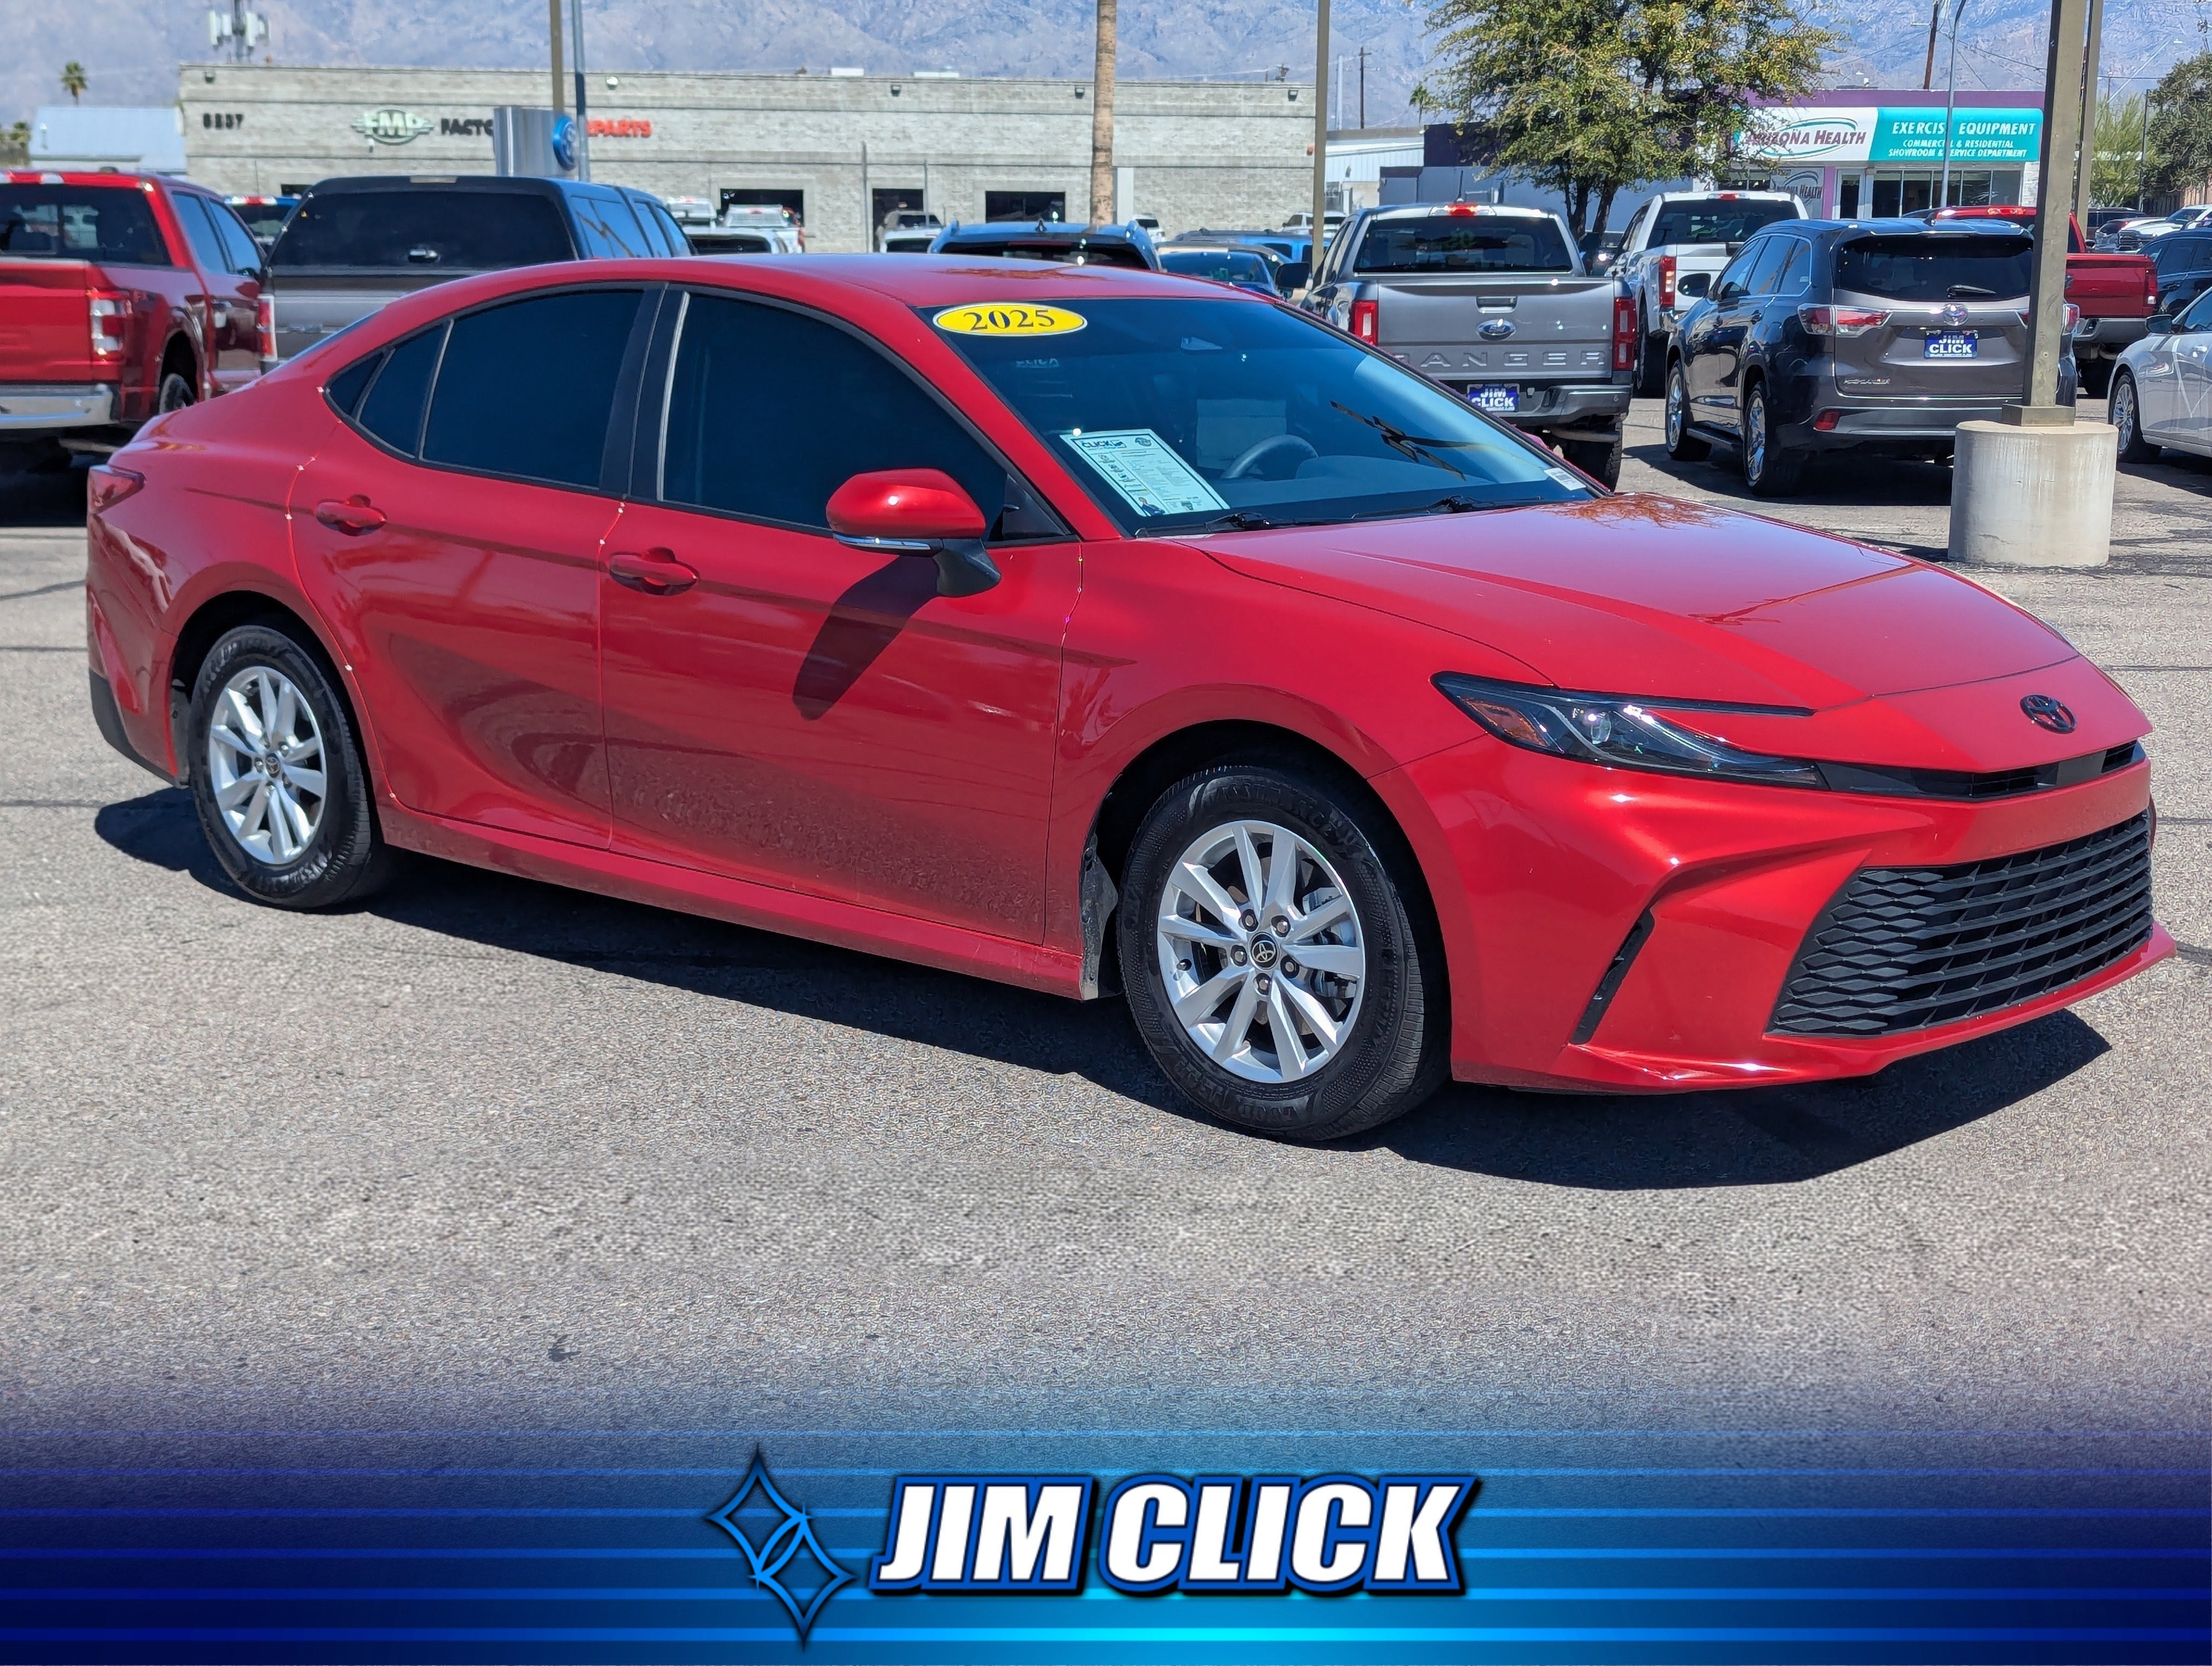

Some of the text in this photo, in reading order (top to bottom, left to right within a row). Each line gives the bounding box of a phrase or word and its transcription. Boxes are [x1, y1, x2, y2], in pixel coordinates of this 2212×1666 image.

[1892, 122, 2036, 135] EXERCIS EQUIPMENT
[1814, 130, 1867, 145] HEALTH
[1903, 139, 1953, 148] COMMERCIL
[1965, 140, 2014, 148] RESIDENTIAL
[1888, 149, 1936, 157] SHOWROOM
[1950, 149, 1976, 157] ERVICE
[1977, 149, 2028, 157] DEPARTMENT
[963, 310, 1055, 331] 2025
[1939, 335, 1964, 343] JIM
[1929, 344, 1972, 353] CLICK
[1480, 388, 1507, 398] JIM
[1471, 398, 1514, 408] CLICK
